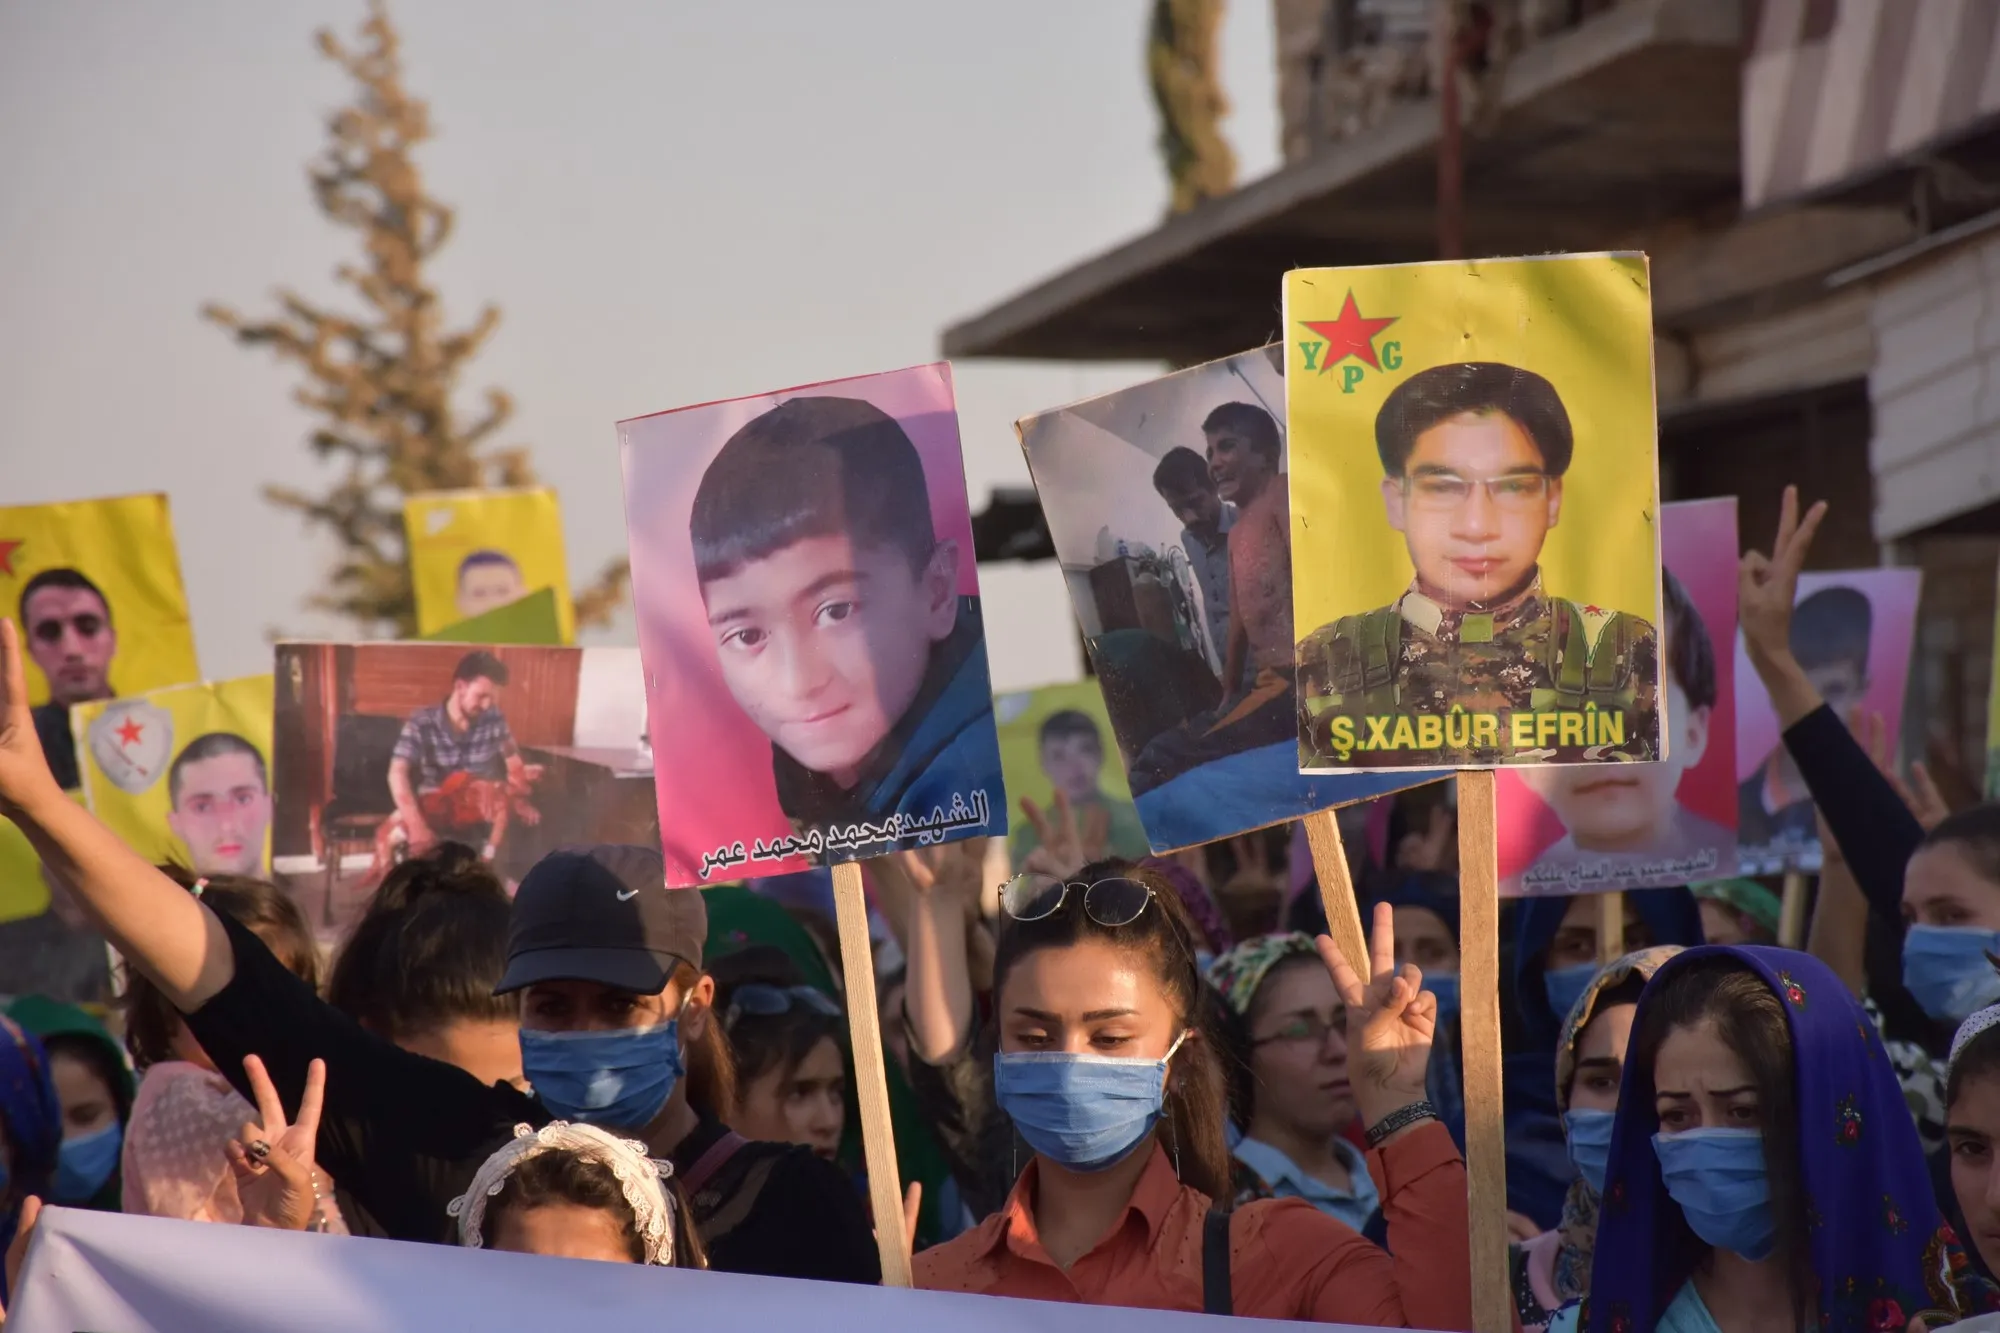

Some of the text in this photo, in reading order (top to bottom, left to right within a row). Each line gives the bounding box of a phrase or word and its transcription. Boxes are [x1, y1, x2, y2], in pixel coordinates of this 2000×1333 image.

[1331, 701, 1626, 762] Ş.XABÛR EFRÎN
[700, 841, 748, 879] عمر
[752, 829, 822, 861] محمد
